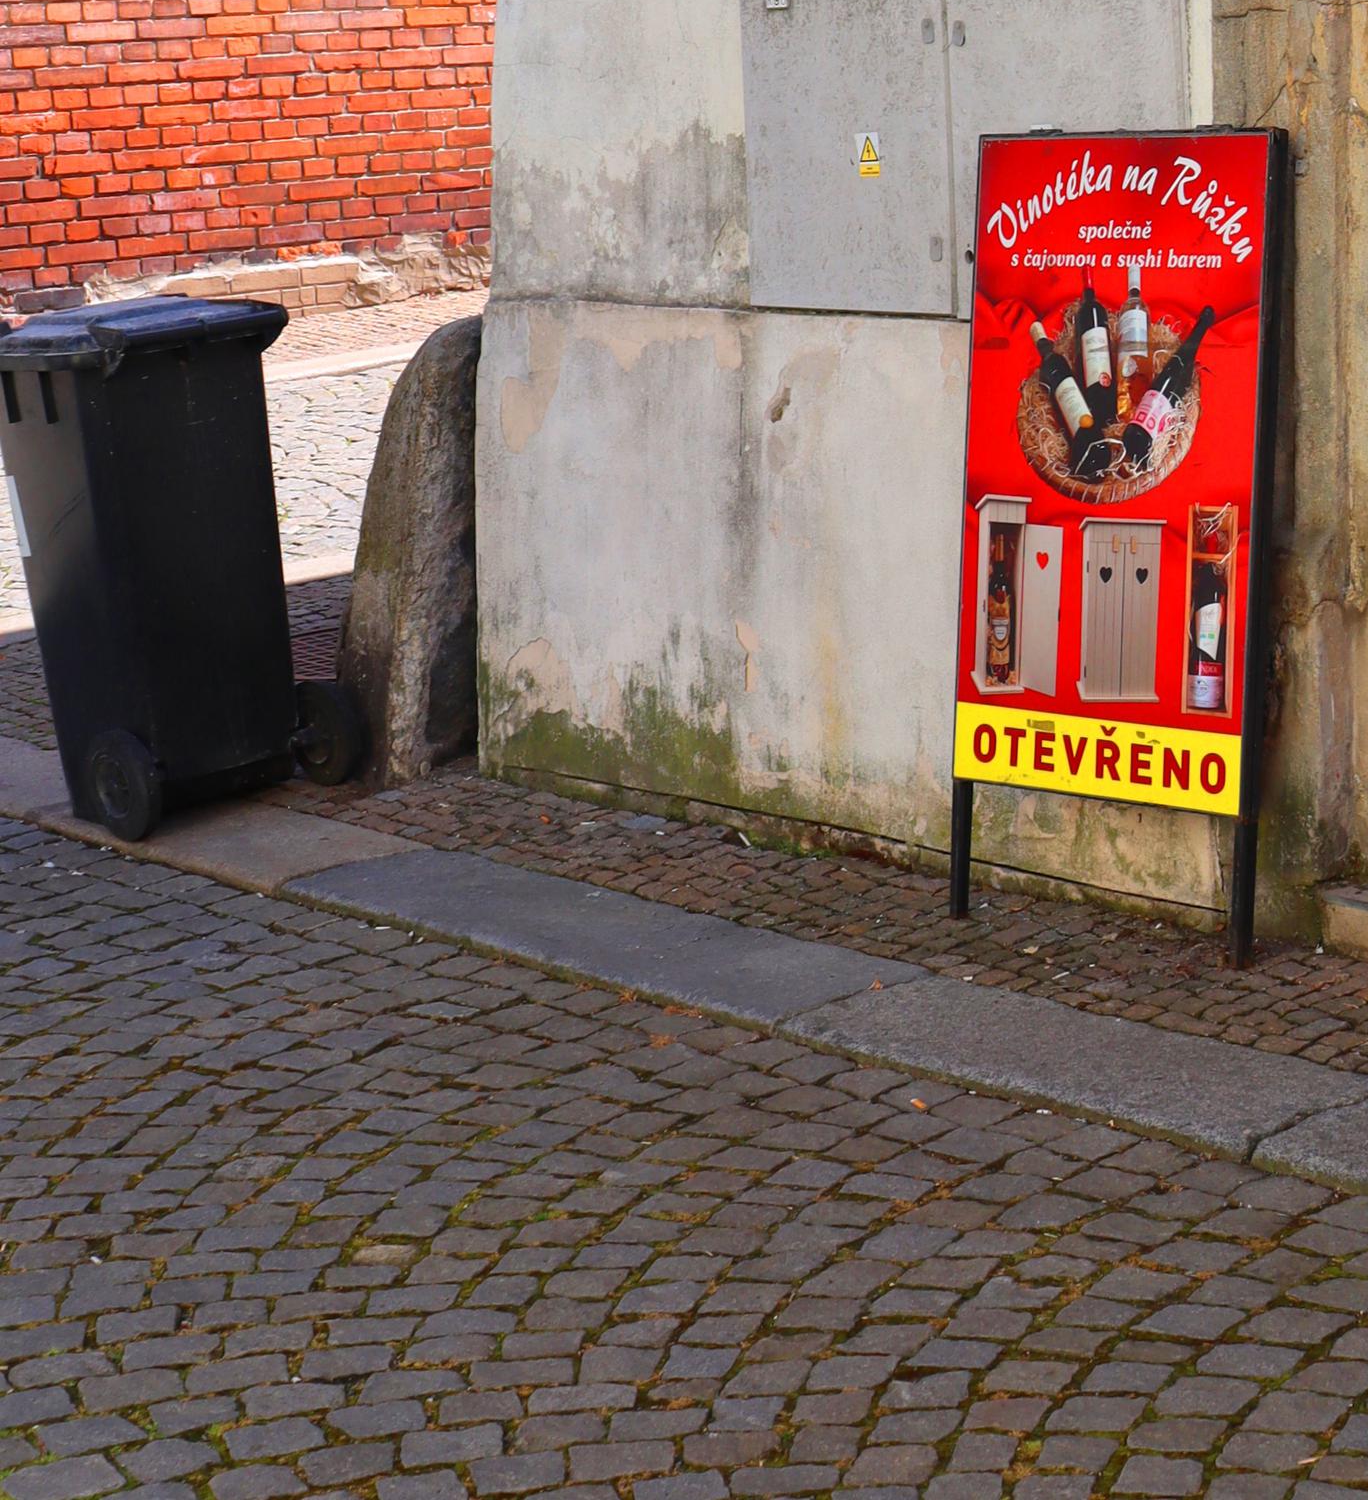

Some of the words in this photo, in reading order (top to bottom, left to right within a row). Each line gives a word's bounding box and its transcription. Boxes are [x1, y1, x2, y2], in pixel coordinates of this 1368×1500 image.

[986, 149, 1113, 249] Vinotéka
[1121, 164, 1159, 196] na
[1160, 155, 1254, 264] Růžku
[1078, 219, 1152, 244] společně
[1010, 252, 1019, 267] s
[1023, 248, 1096, 272] čajovnou
[1101, 253, 1112, 268] a
[1117, 248, 1163, 268] sushi
[1166, 248, 1222, 268] barem
[973, 723, 1227, 795] OTEVŘENO
